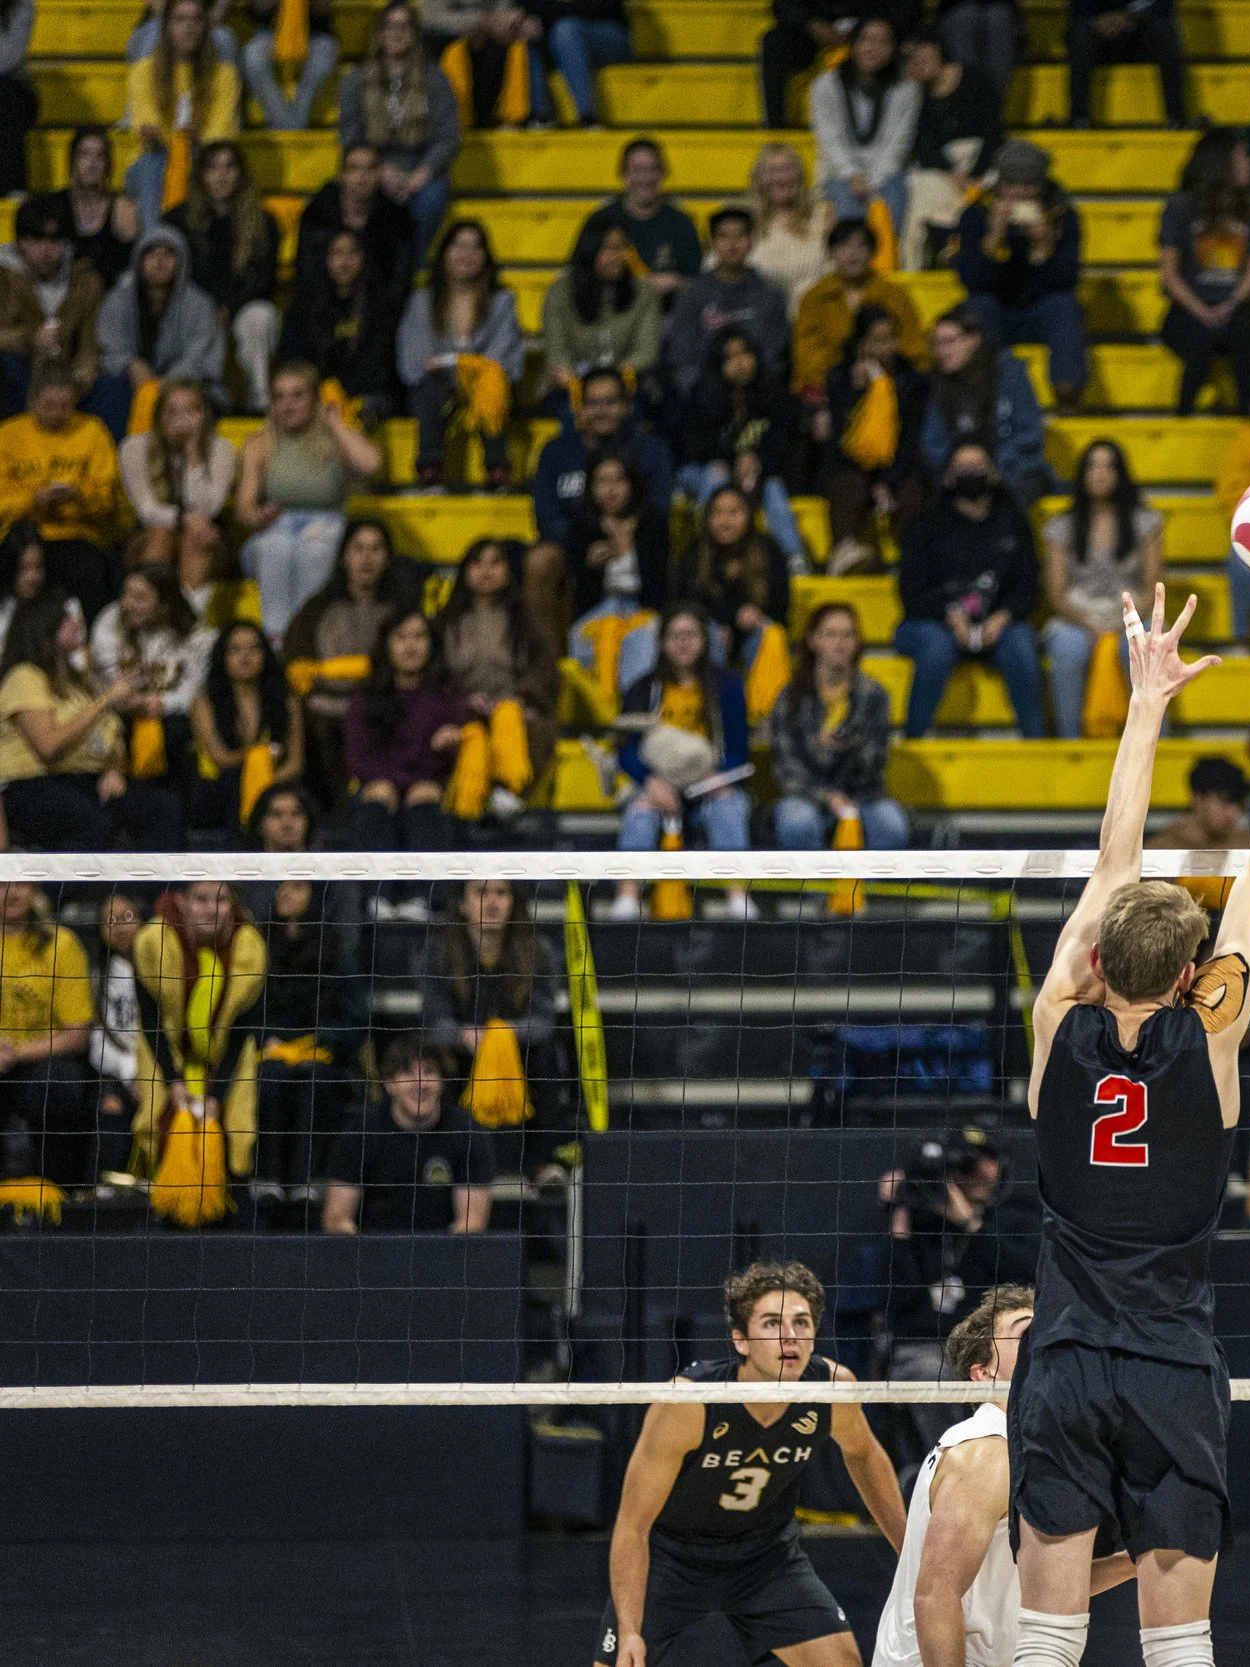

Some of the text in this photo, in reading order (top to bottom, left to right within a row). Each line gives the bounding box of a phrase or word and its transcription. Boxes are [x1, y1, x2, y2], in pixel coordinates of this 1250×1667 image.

[1090, 1073, 1149, 1167] 2
[701, 1446, 813, 1469] BEACH
[718, 1467, 772, 1513] 3
